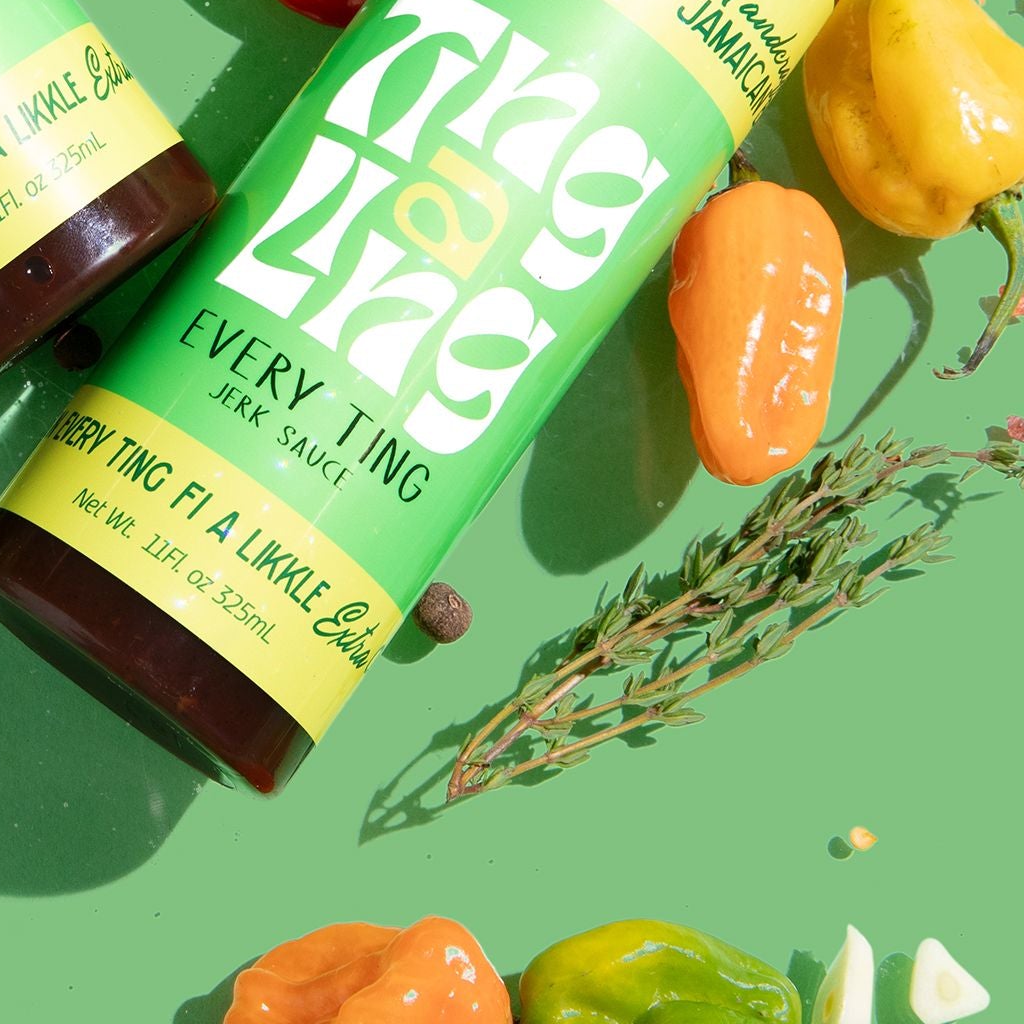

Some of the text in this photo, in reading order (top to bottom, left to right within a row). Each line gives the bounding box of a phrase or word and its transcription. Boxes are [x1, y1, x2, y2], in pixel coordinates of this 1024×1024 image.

[4, 71, 87, 146] LIKKLE
[48, 132, 107, 182] 325mL
[394, 145, 509, 281] a
[179, 308, 430, 503] EVERY TING
[208, 382, 354, 491] JERK SAUCE
[53, 411, 116, 455] EVERY
[106, 436, 173, 492] TING
[170, 480, 214, 520] FI
[206, 511, 240, 544] A
[236, 528, 330, 614] LIKKLE
[72, 487, 104, 520] Net
[104, 506, 137, 539] Wt.
[187, 568, 216, 594] oz
[212, 585, 276, 645] 325mL
